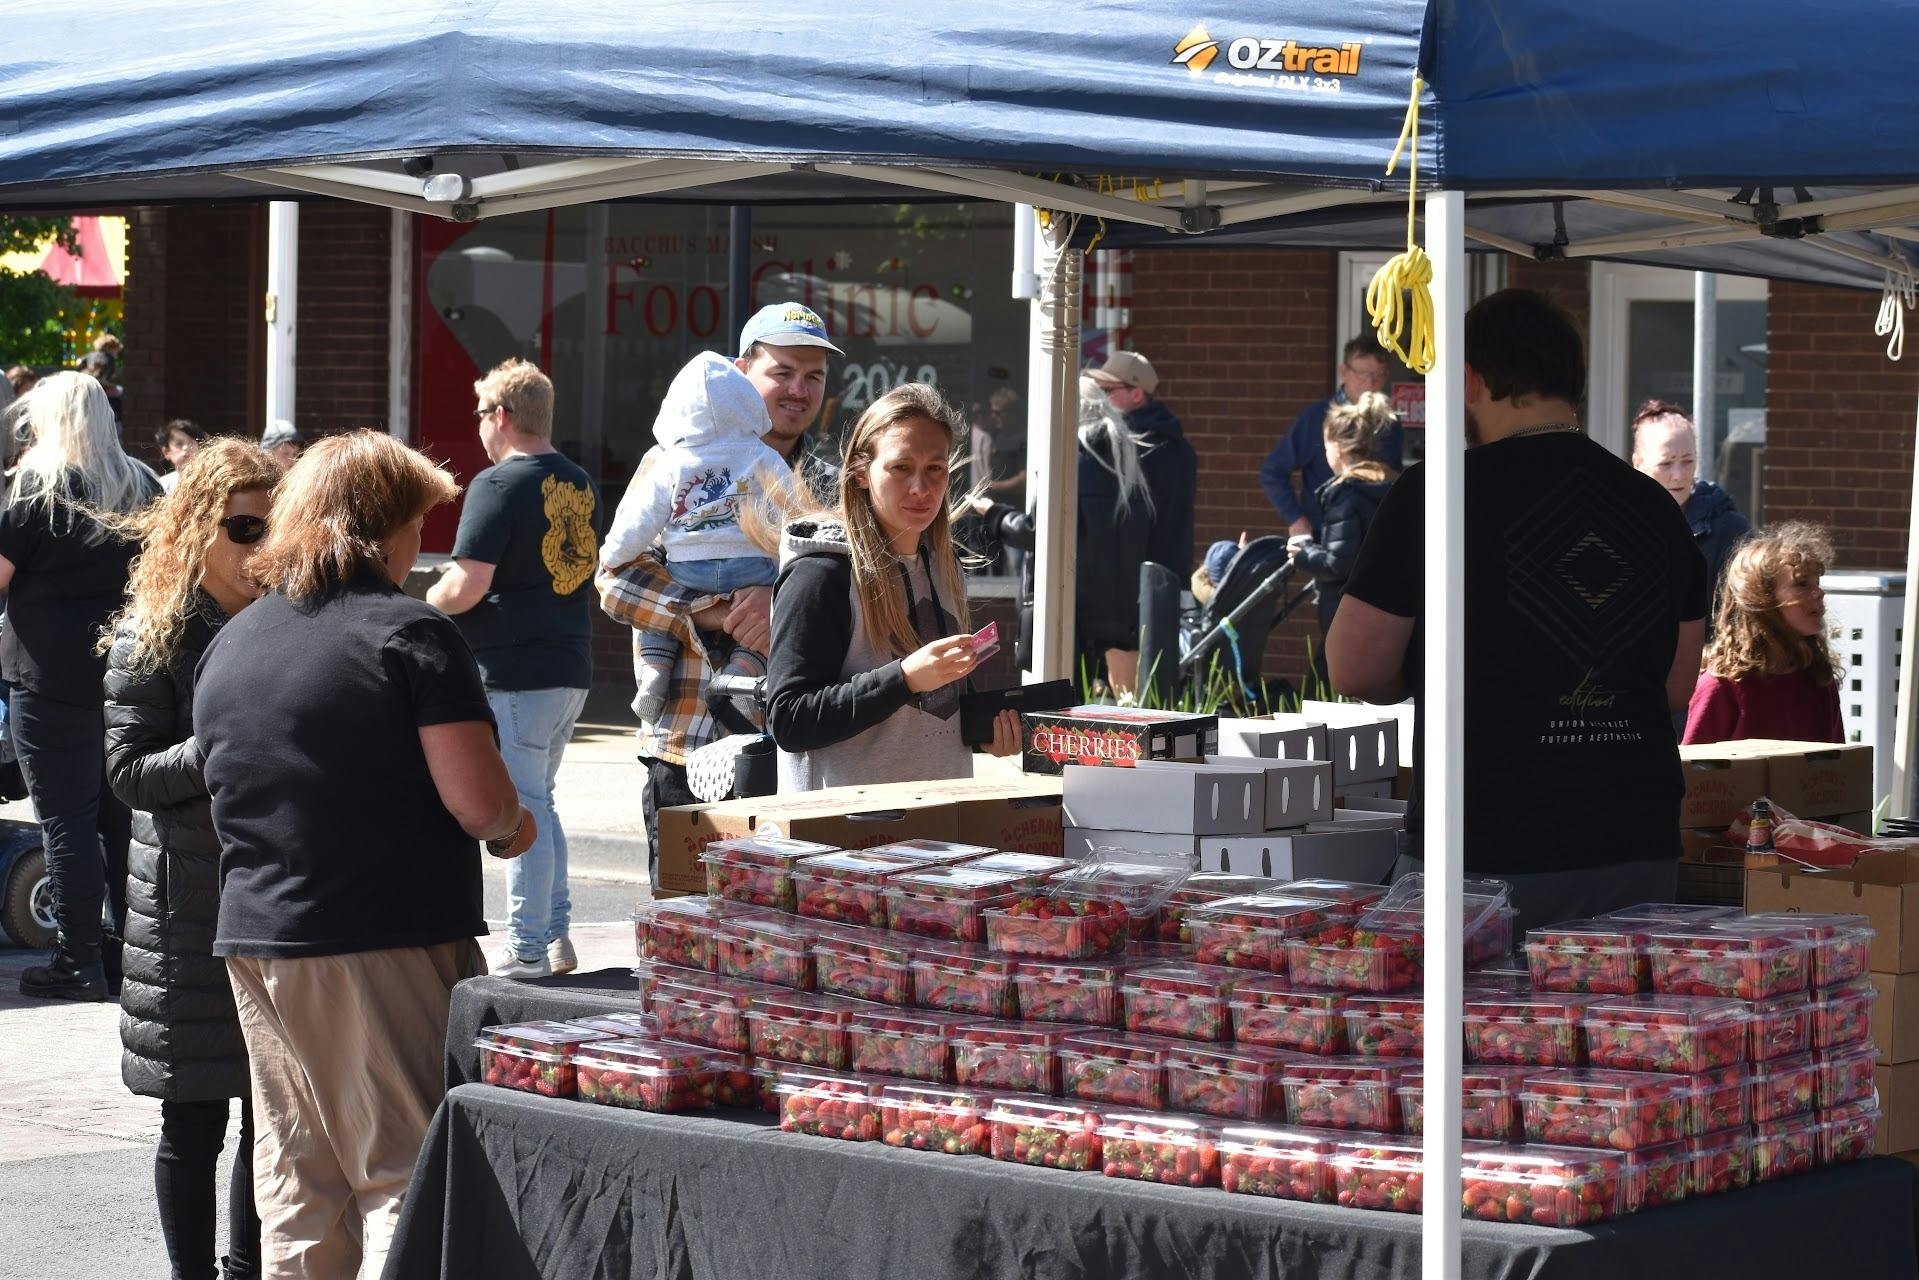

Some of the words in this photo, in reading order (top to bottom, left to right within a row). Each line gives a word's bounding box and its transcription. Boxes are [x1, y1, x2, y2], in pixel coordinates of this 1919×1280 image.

[1227, 36, 1362, 76] OZtrail
[1276, 75, 1309, 92] DLX
[1312, 77, 1342, 94] 3x3
[605, 235, 697, 255] BACCHUS
[705, 235, 780, 254] MSH
[604, 260, 721, 338] Foo
[751, 257, 941, 340] Clinic
[1550, 719, 1585, 729] UNION
[1033, 731, 1138, 761] CHERRIES
[1540, 735, 1583, 744] FUTURE
